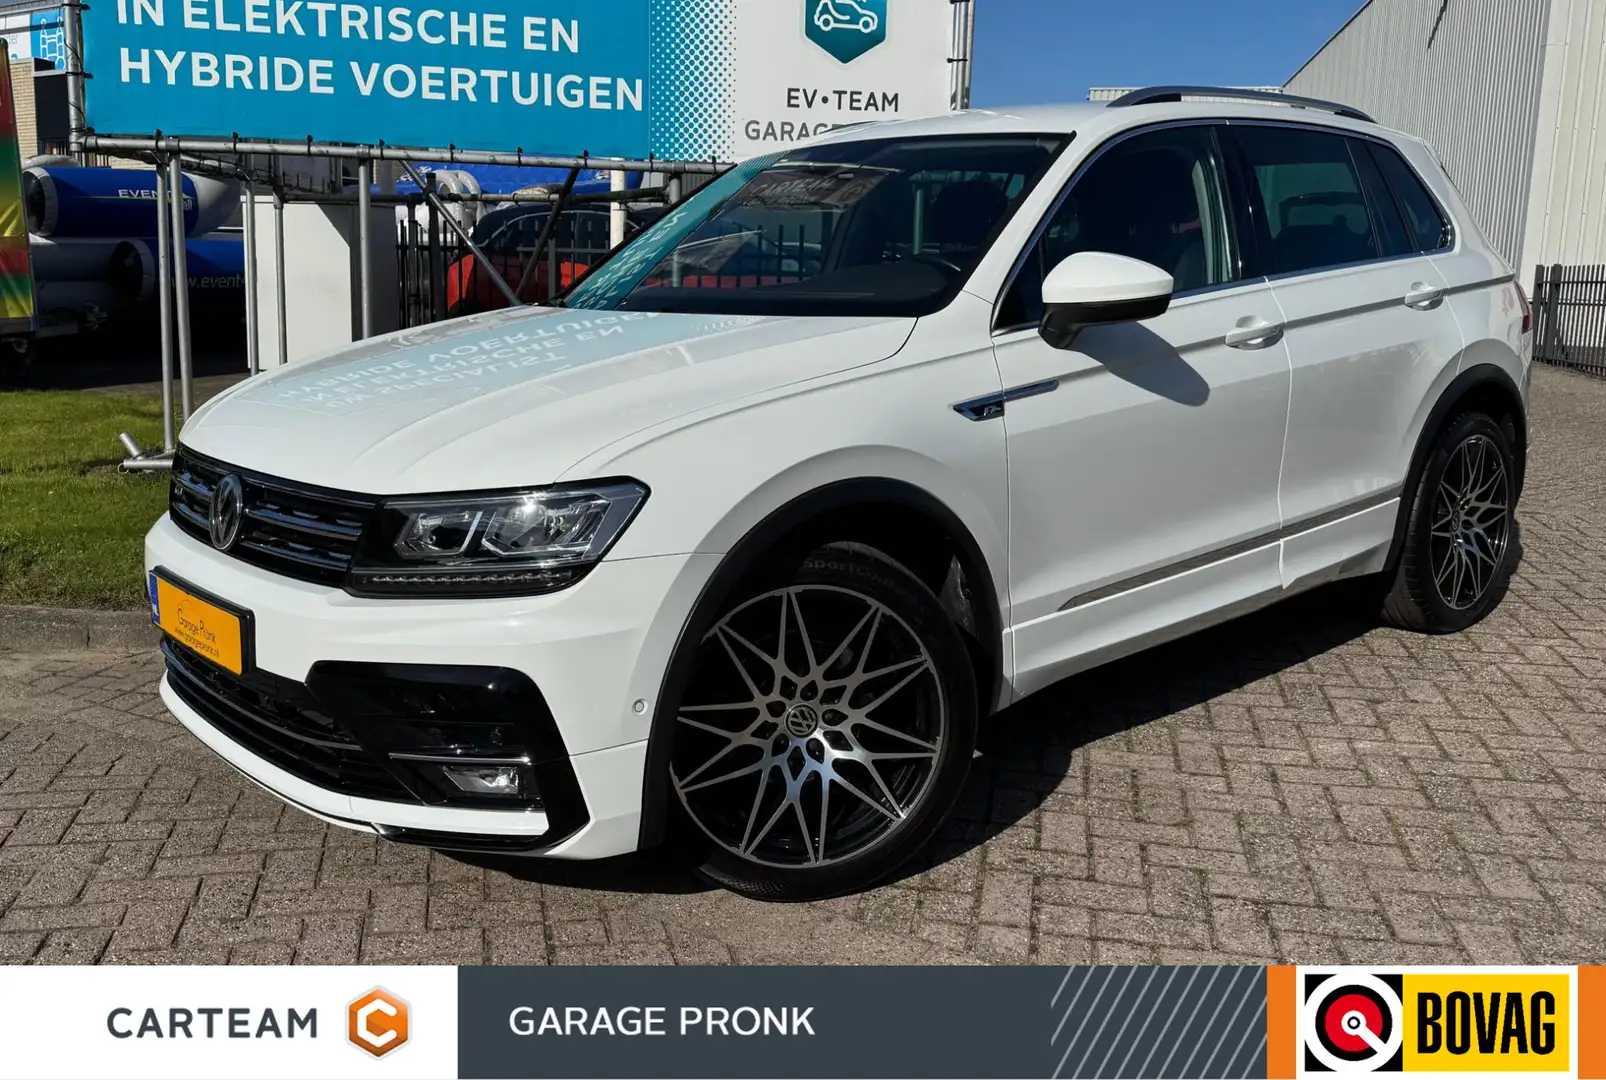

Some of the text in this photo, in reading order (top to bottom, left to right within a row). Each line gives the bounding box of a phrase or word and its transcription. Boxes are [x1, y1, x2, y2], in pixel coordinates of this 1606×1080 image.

[117, 0, 579, 53] IN ELEKTRISCHE EN
[120, 47, 643, 111] HYBRIDE VOERTUIGEN
